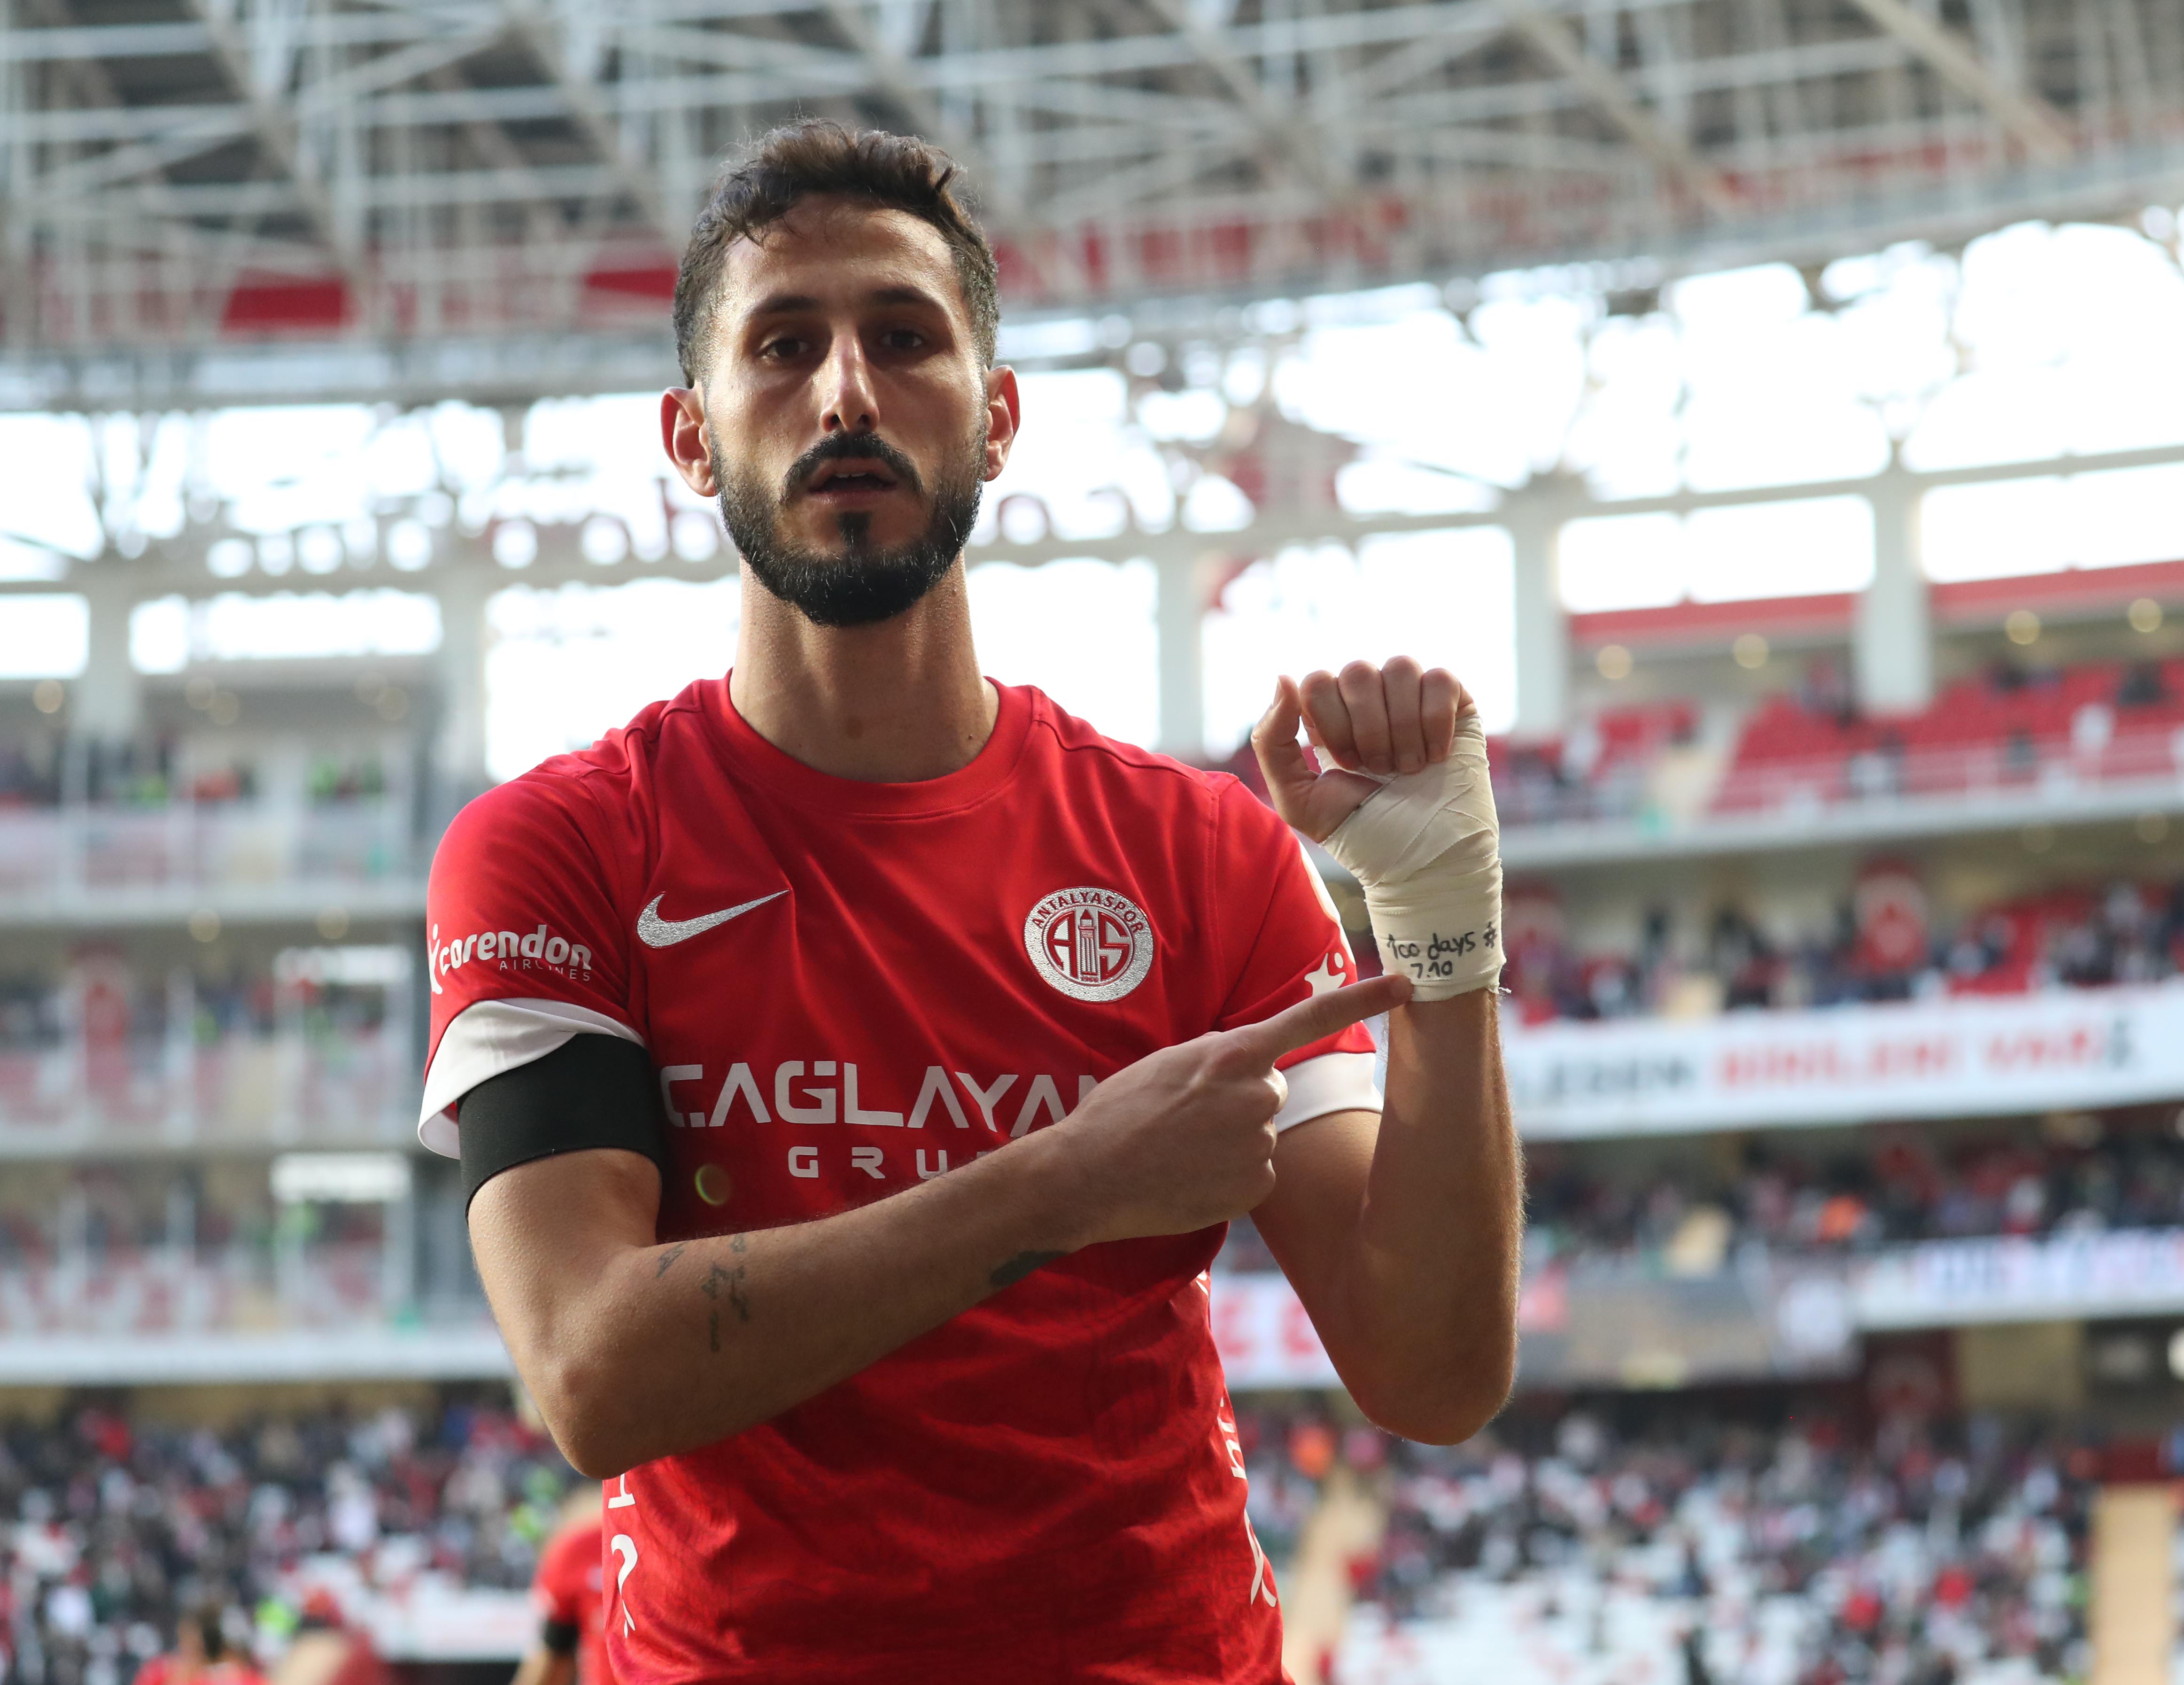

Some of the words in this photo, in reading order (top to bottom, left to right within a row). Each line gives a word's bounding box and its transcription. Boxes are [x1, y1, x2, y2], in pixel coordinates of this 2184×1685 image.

[1032, 892, 1144, 933] ANTALYASPOR
[439, 924, 592, 976] corendon
[1427, 931, 1476, 960] days
[788, 1146, 989, 1180] GRU
